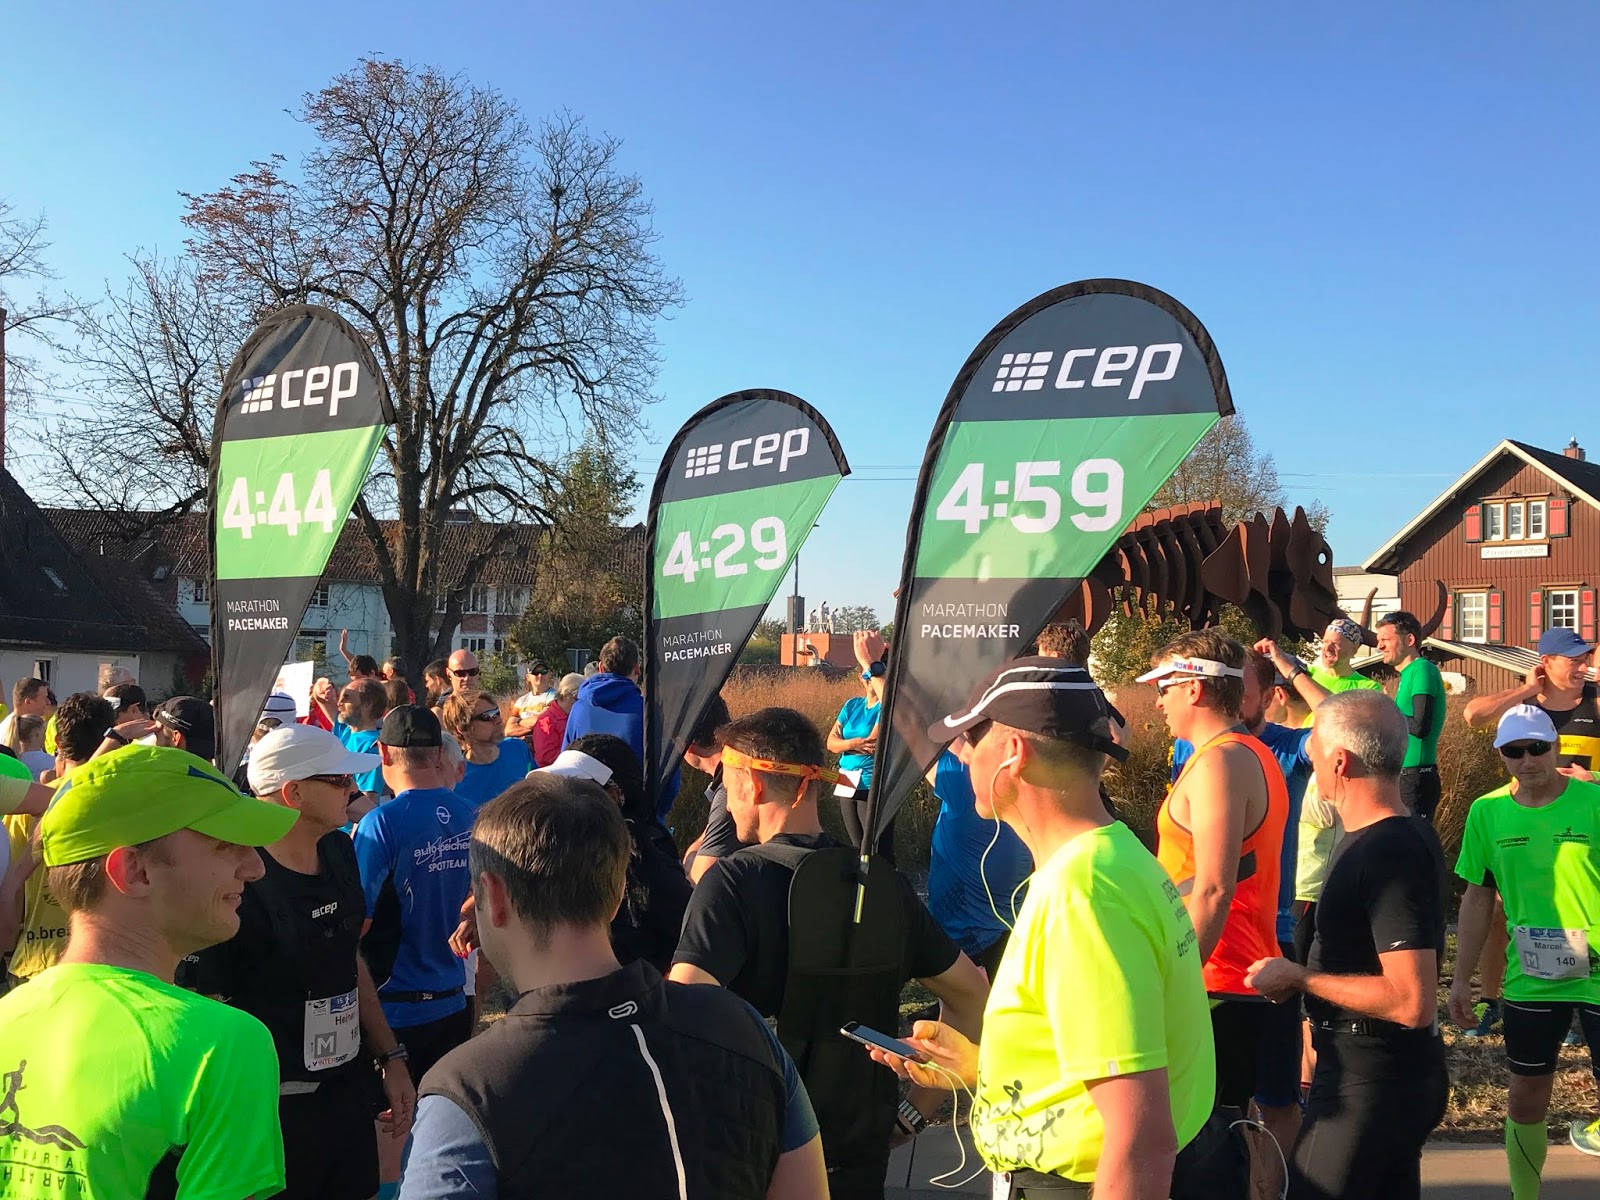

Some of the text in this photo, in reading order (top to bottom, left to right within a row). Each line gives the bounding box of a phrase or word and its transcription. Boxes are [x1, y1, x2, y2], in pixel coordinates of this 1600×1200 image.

[1055, 343, 1183, 400] cep
[281, 361, 359, 416] cep
[727, 427, 810, 472] cep
[222, 468, 337, 539] 4:44
[936, 458, 1124, 534] 4:59
[662, 516, 787, 583] 4:29
[226, 600, 280, 613] MARATHON
[922, 603, 1008, 617] MARATHON
[228, 617, 288, 631] PACEMAKER
[921, 624, 1020, 638] PACEMAKER
[662, 628, 723, 647] MARATHON
[664, 642, 732, 662] PACEMAKER
[319, 901, 337, 915] cep
[26, 926, 71, 944] p.bre
[1534, 942, 1562, 950] Marcel
[1556, 957, 1576, 966] 140
